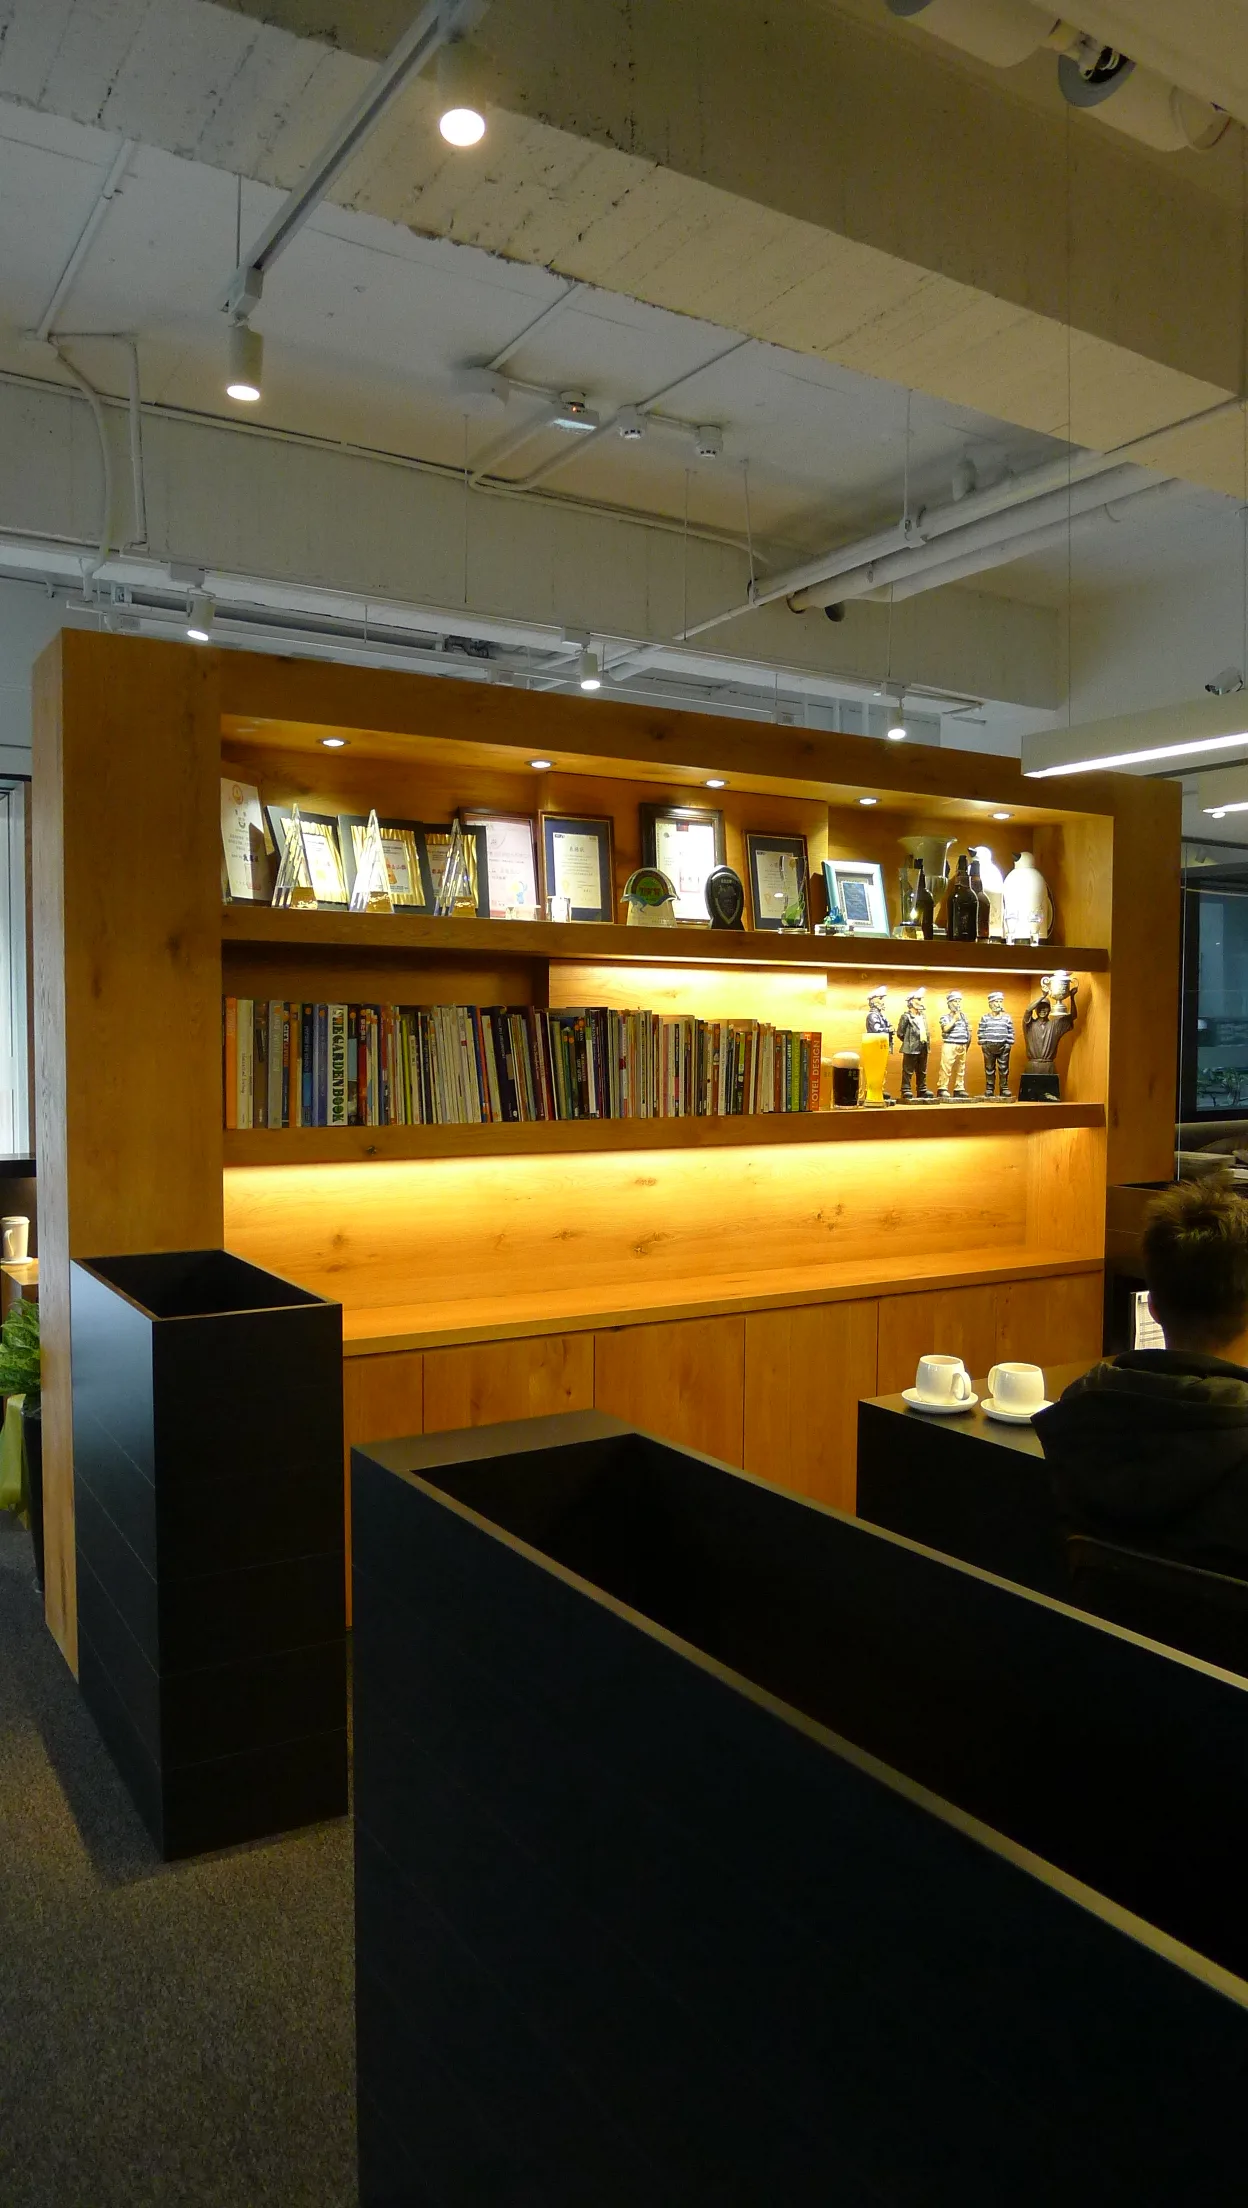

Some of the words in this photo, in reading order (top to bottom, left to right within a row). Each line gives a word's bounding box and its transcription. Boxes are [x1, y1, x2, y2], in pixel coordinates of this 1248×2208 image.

[332, 1034, 344, 1087] GARDEN
[812, 1040, 820, 1076] DESIGN
[332, 1089, 344, 1123] BOOK
